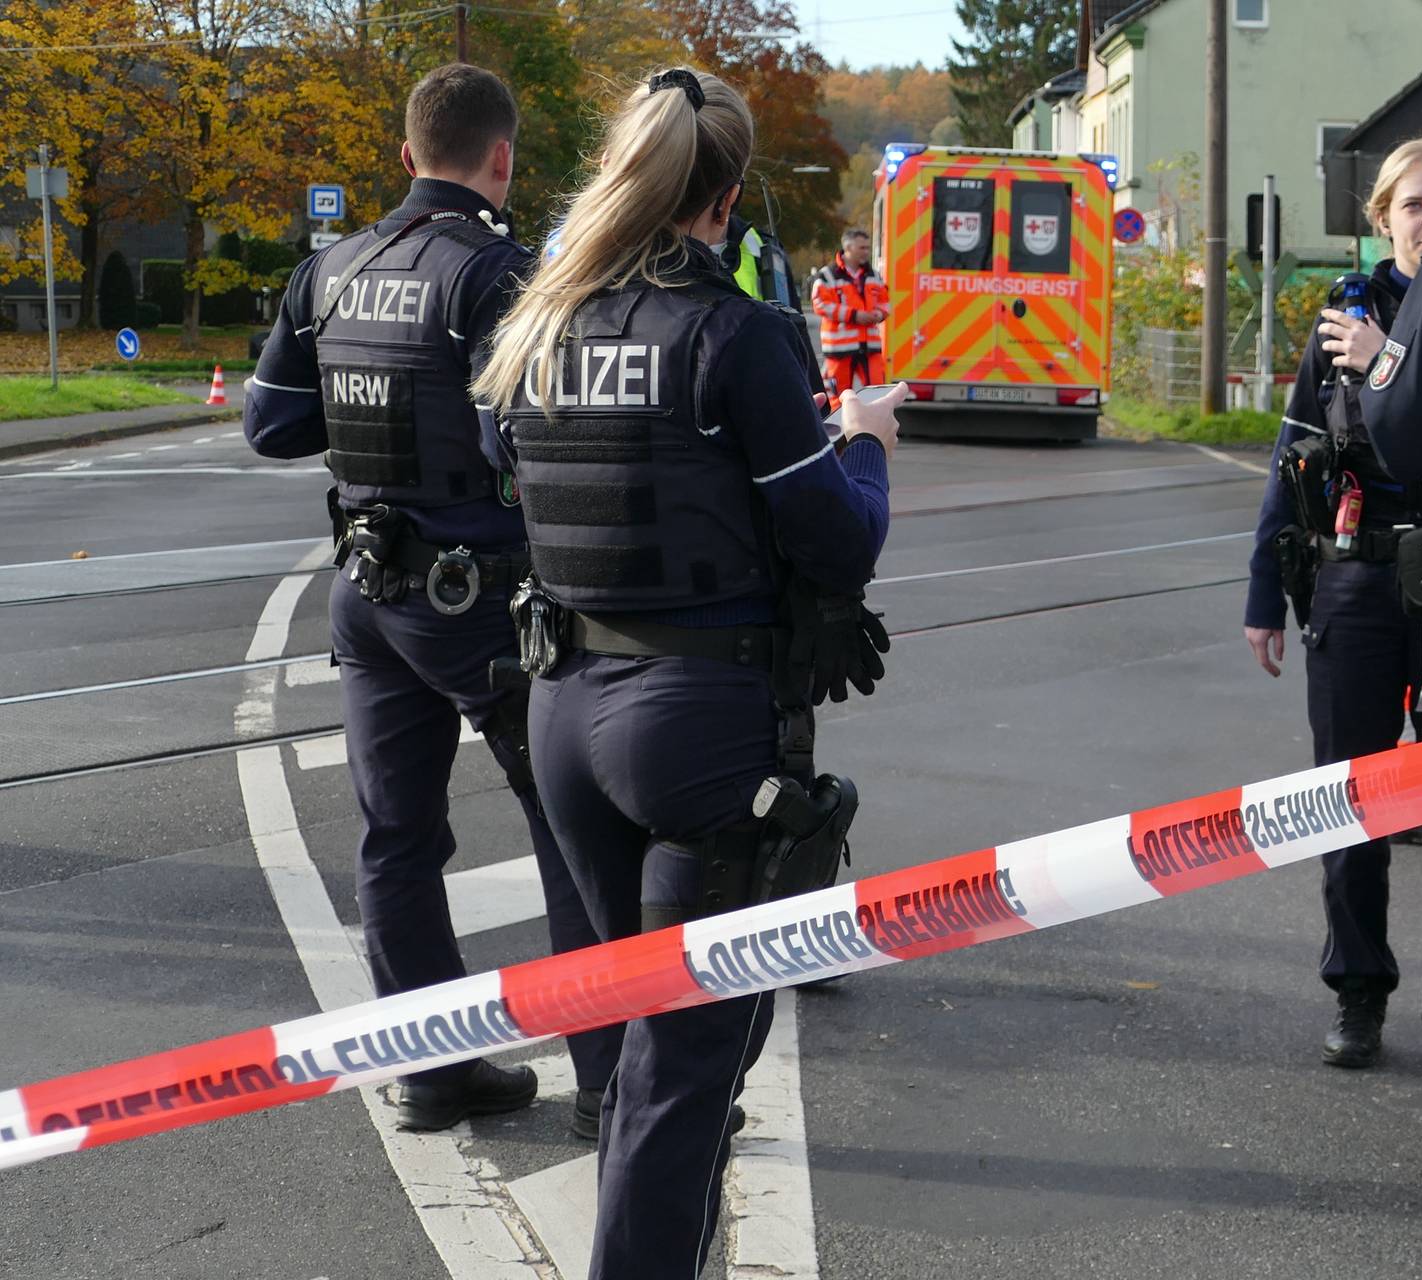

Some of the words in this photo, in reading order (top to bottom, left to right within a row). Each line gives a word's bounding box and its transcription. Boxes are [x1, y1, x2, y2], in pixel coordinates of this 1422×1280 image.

[431, 211, 467, 221] Canon
[919, 274, 1079, 297] RETTUNGSDIENST
[333, 371, 391, 407] NRW
[524, 345, 660, 407] OLIZEI
